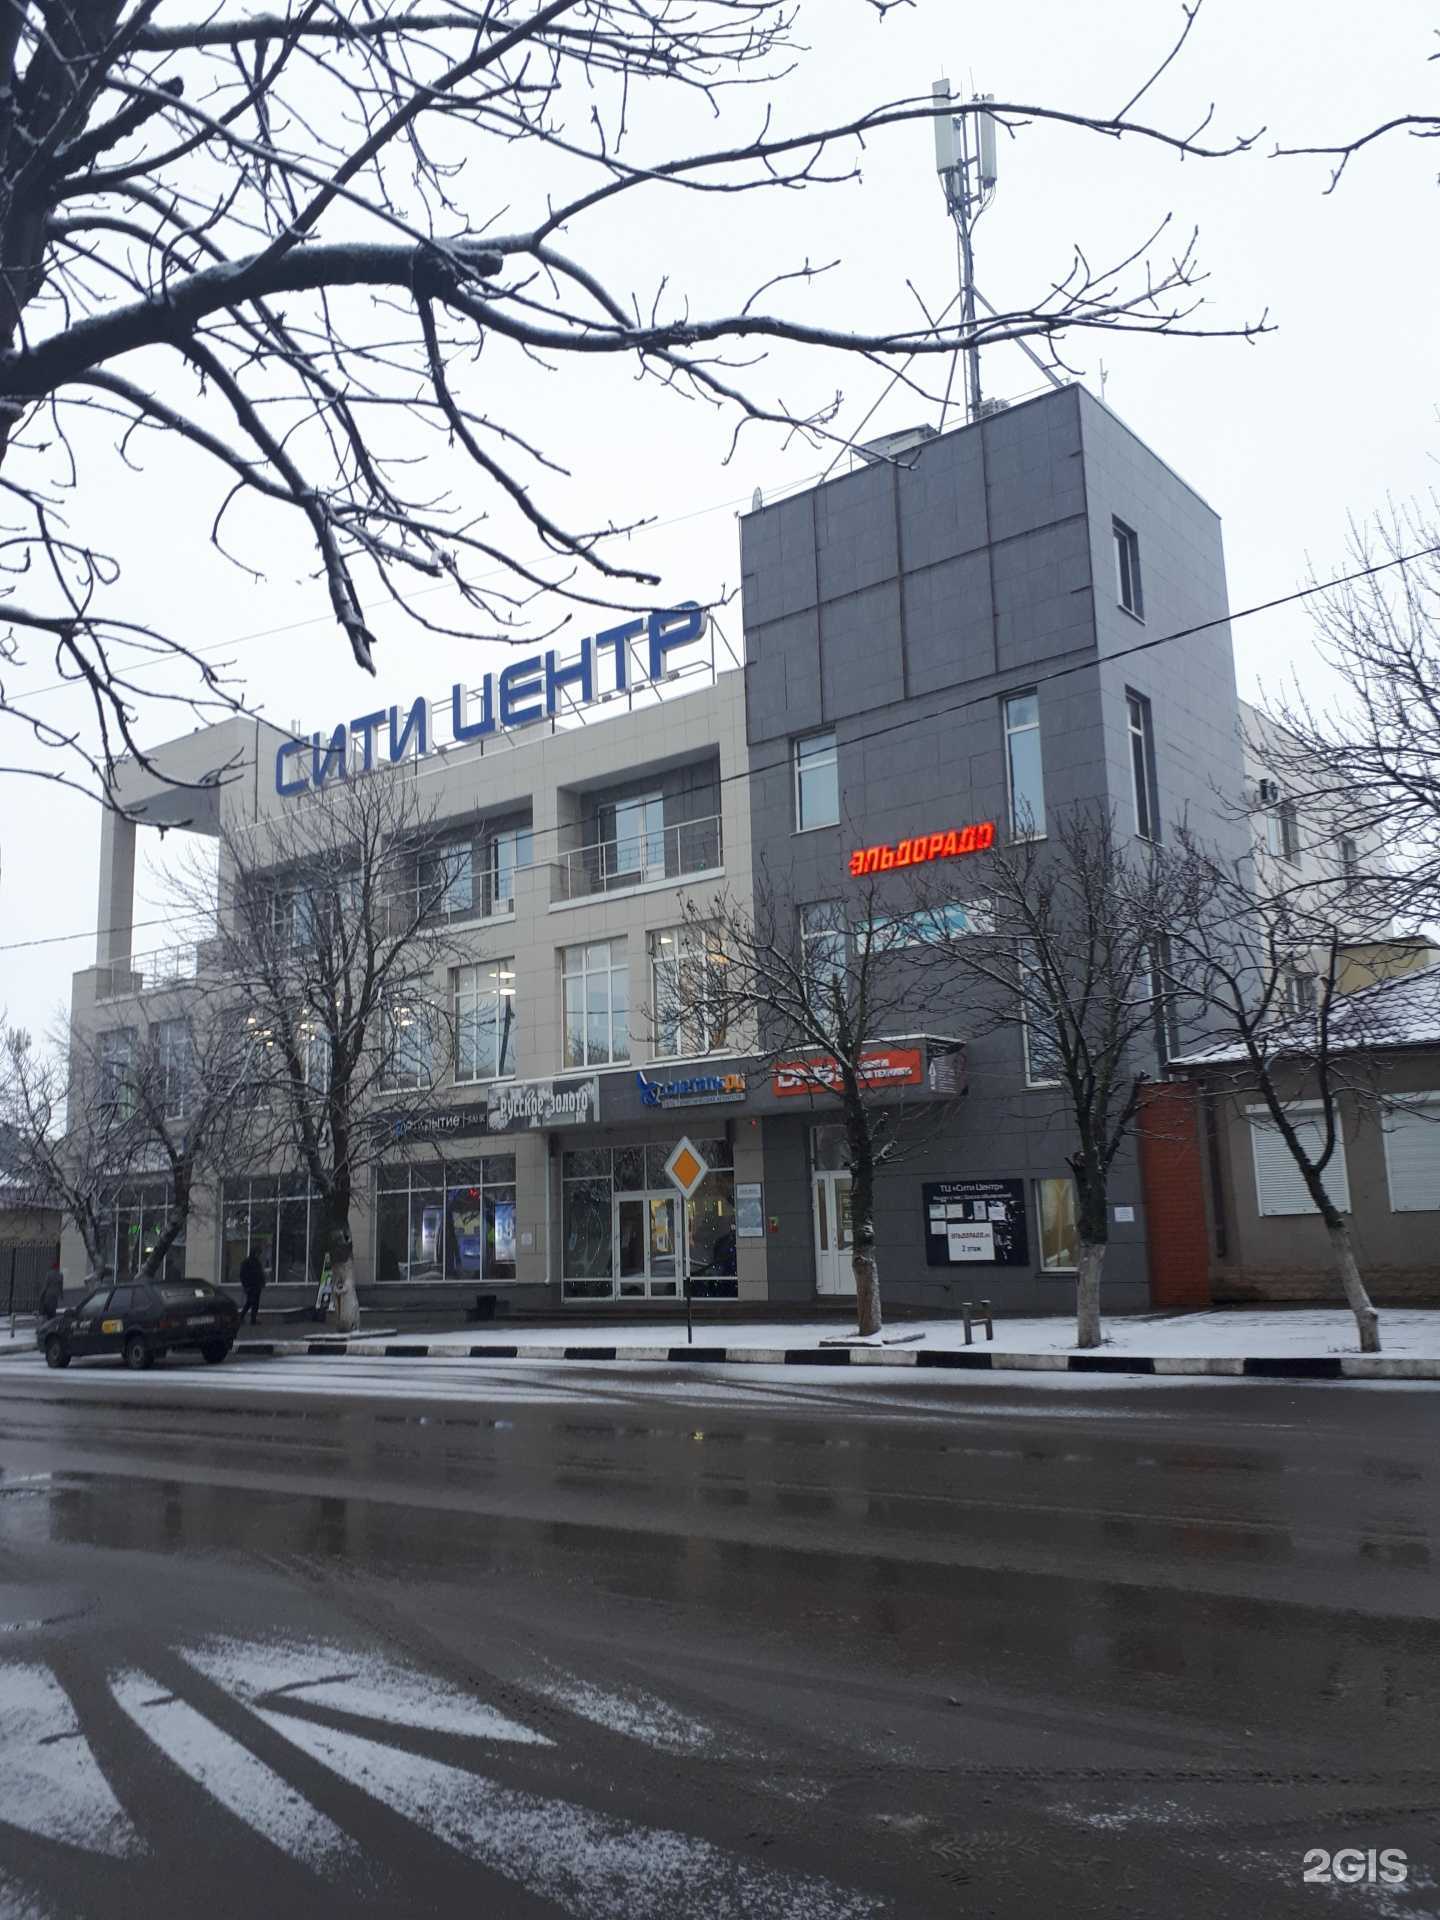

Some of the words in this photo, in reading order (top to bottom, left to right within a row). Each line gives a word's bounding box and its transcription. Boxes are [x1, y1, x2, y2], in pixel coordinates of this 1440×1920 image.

[276, 696, 433, 796] СИТИ
[452, 600, 708, 741] ЦЕНТР
[849, 821, 994, 877] ЭЛЬДОРАДО
